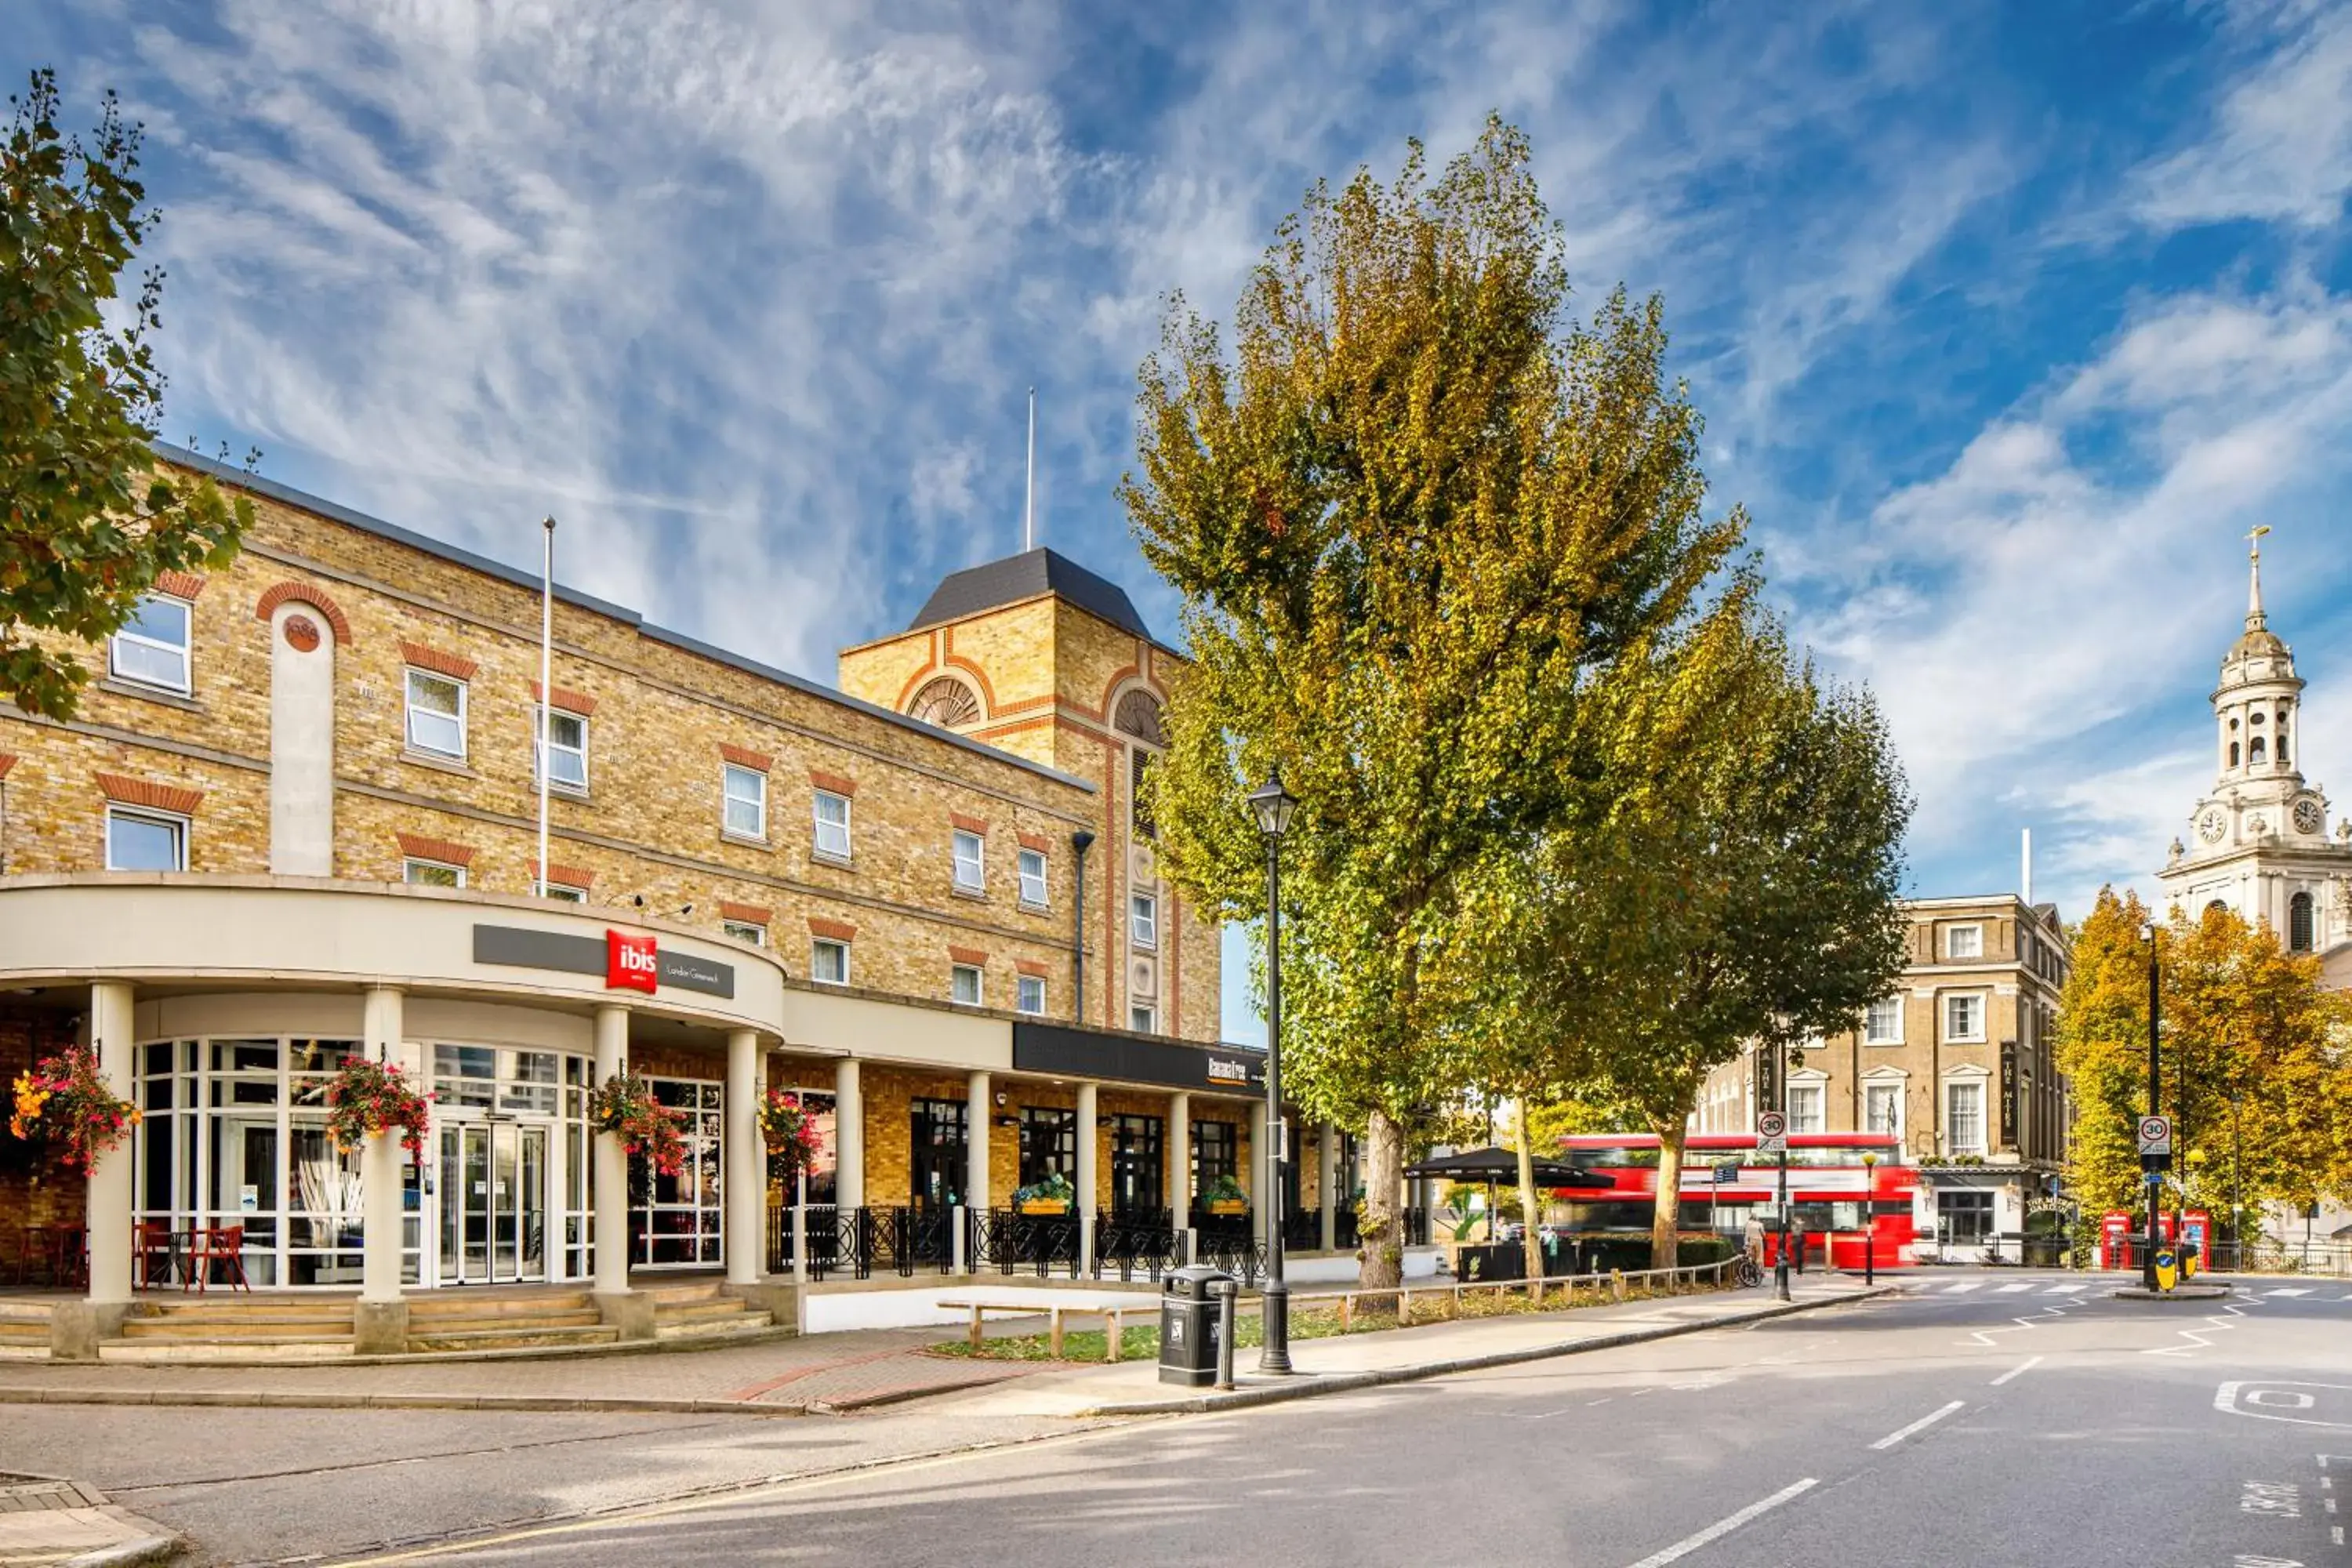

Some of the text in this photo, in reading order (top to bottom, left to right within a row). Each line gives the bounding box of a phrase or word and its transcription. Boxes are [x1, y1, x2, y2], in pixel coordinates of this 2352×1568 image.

[620, 944, 657, 973] ibis
[1764, 1120, 1780, 1130] 30
[2147, 1123, 2162, 1134] 30
